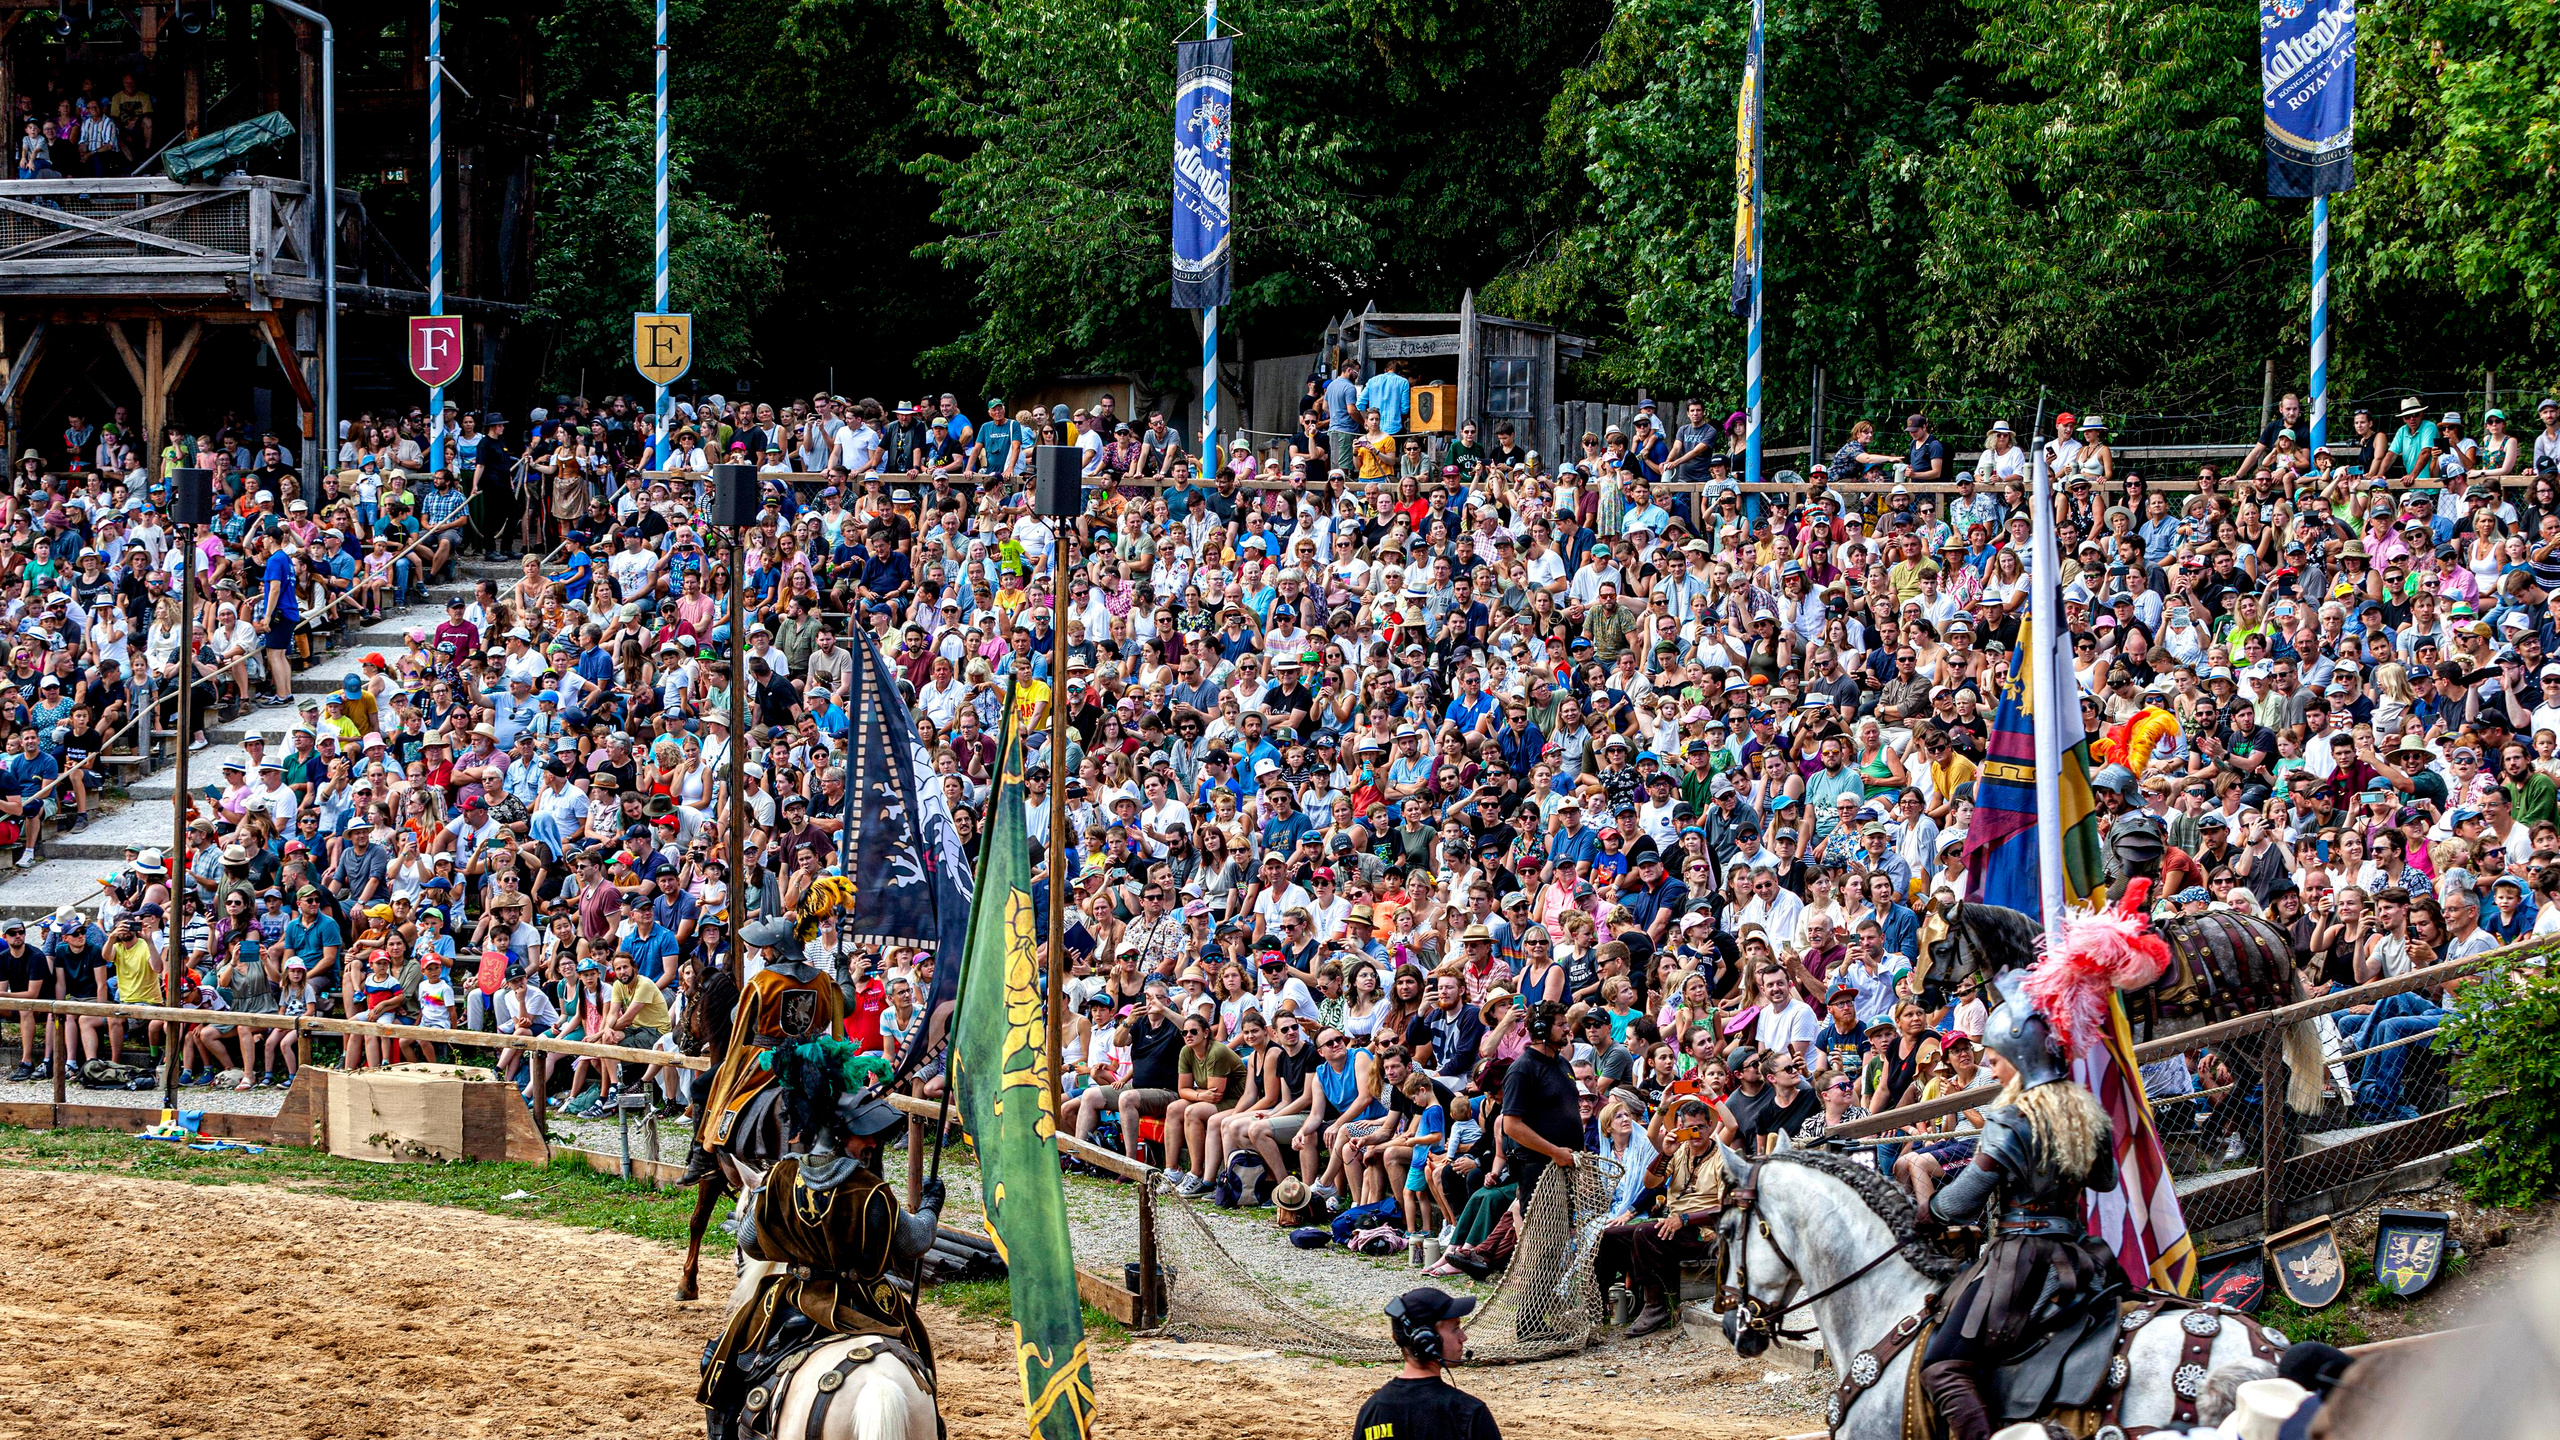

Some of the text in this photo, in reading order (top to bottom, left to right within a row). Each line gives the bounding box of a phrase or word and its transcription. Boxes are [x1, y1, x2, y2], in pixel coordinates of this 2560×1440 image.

[2286, 69, 2331, 111] ROYAL
[419, 327, 455, 371] F
[644, 324, 682, 368] E
[1683, 434, 1702, 443] VANS
[1569, 970, 1593, 982] TROUBLE
[1570, 963, 1586, 972] HERE
